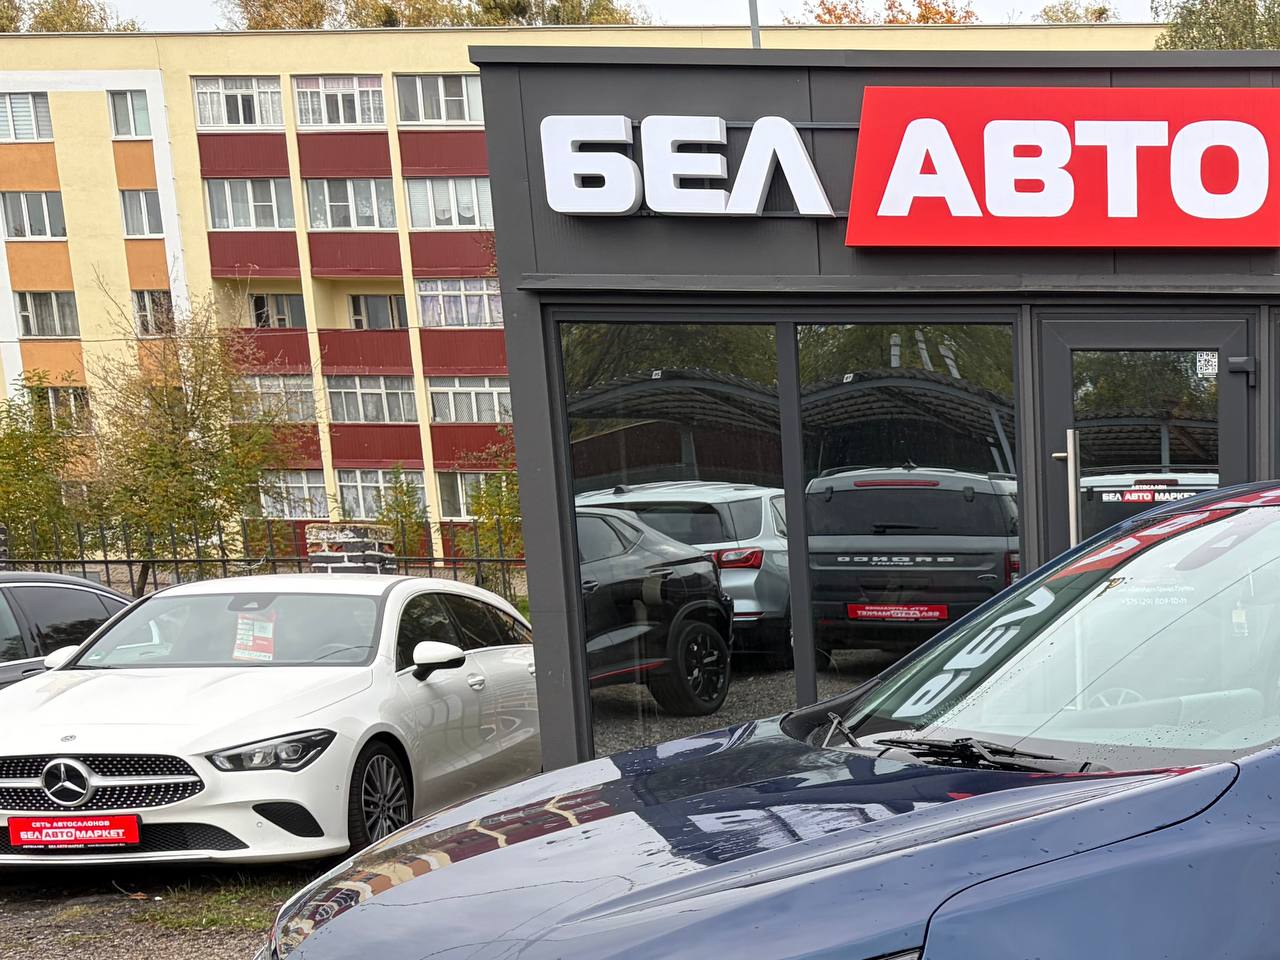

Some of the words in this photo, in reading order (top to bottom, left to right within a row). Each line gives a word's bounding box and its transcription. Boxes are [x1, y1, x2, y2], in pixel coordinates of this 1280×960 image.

[540, 115, 835, 217] БЕЛ
[877, 118, 1270, 219] АВТО
[1102, 493, 1122, 502] БЕЛ
[1124, 493, 1152, 501] АВТО
[53, 820, 110, 828] АВТОСАЛОНОВ
[20, 831, 42, 839] БЕЛ
[43, 830, 74, 839] АВТО
[76, 829, 125, 839] МАРКЕТ
